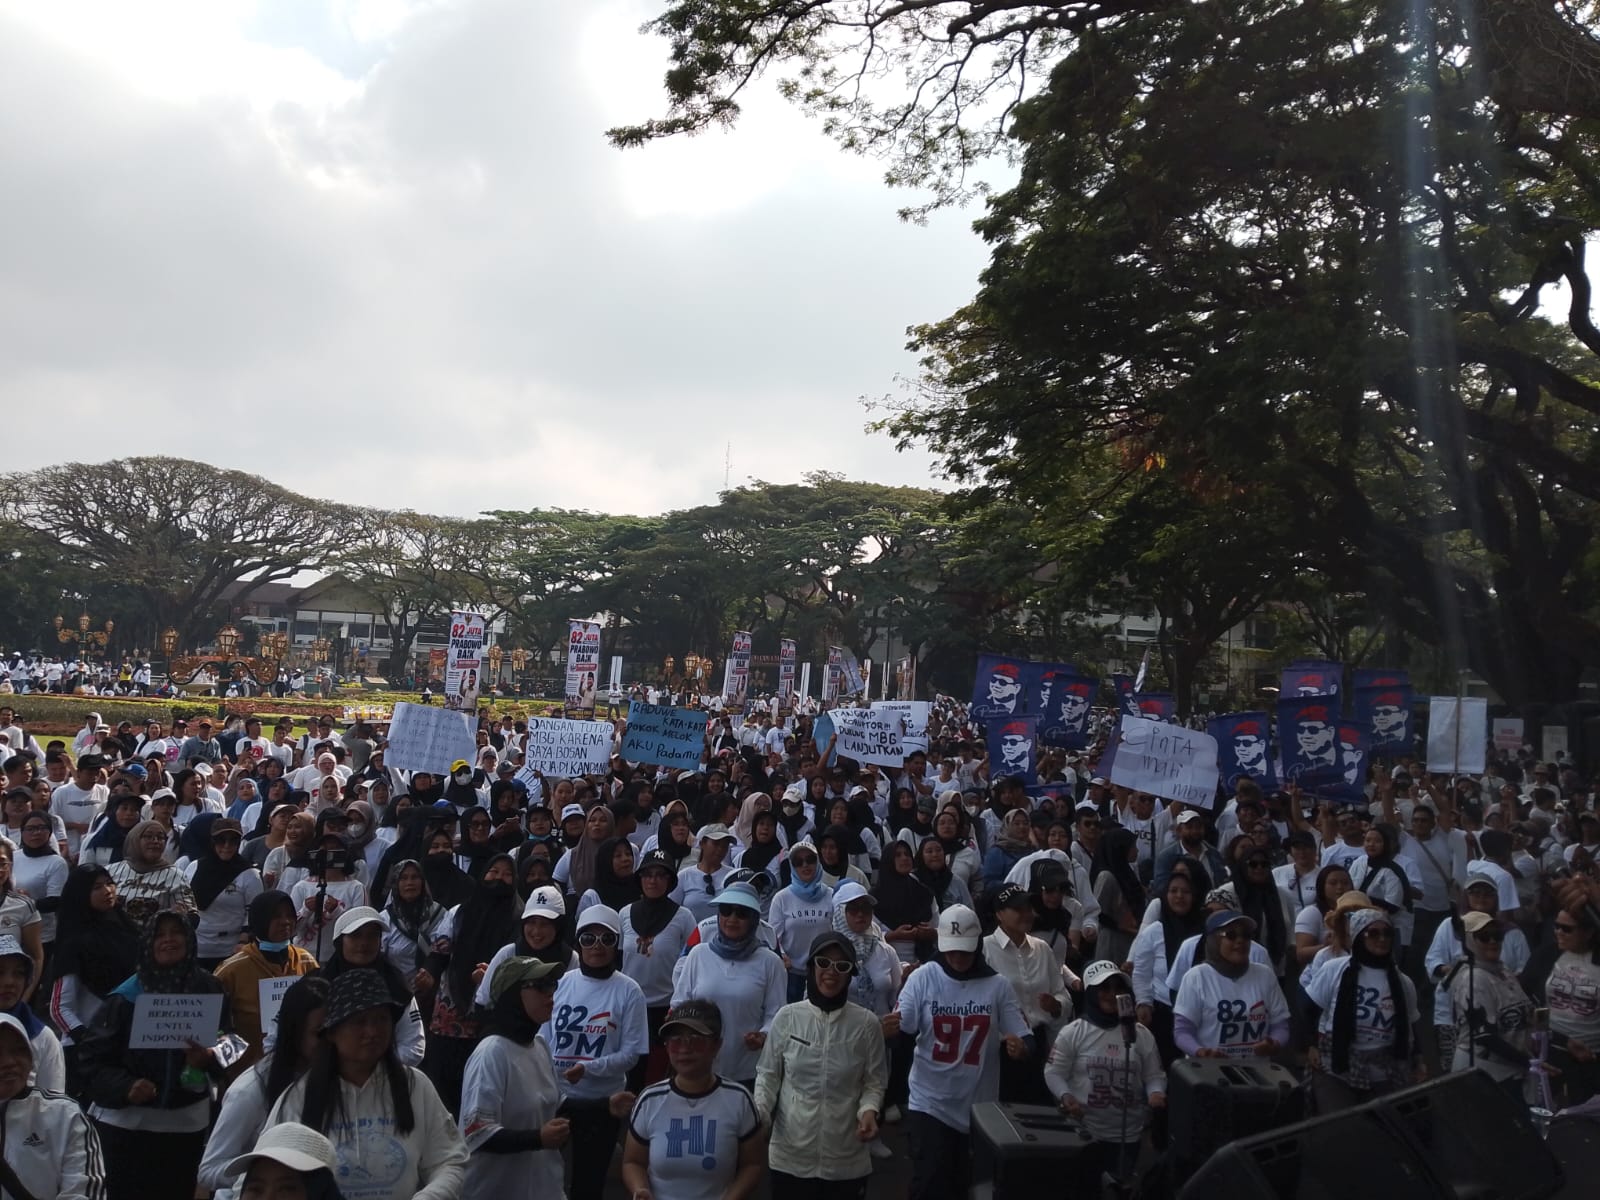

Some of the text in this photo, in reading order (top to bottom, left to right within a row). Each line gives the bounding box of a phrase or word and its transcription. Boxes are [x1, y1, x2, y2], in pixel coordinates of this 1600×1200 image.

[452, 624, 482, 639] 82 JUTA
[571, 630, 584, 644] 82
[451, 638, 482, 650] PRABOWO
[570, 645, 599, 654] PRABOWO
[457, 649, 475, 660] BAIK
[576, 653, 593, 663] BAIK
[530, 719, 613, 734] JANGAN TUTUP
[626, 722, 660, 734] POKOK
[529, 731, 604, 747] MBG KARENA
[662, 729, 693, 743] MELOK
[868, 731, 897, 745] MBG
[627, 739, 654, 751] AKU
[844, 738, 904, 756] LANJUTKAN
[950, 921, 962, 936] R
[152, 998, 203, 1007] RELAWAN
[931, 999, 993, 1016] Brainstore
[147, 1010, 203, 1019] BERGERAK
[555, 1003, 607, 1034] 82 JUTA
[1217, 999, 1248, 1024] 82
[156, 1022, 192, 1031] UNTUK
[1219, 1021, 1266, 1045] PM
[555, 1031, 608, 1059] PM
[932, 1014, 991, 1066] 97
